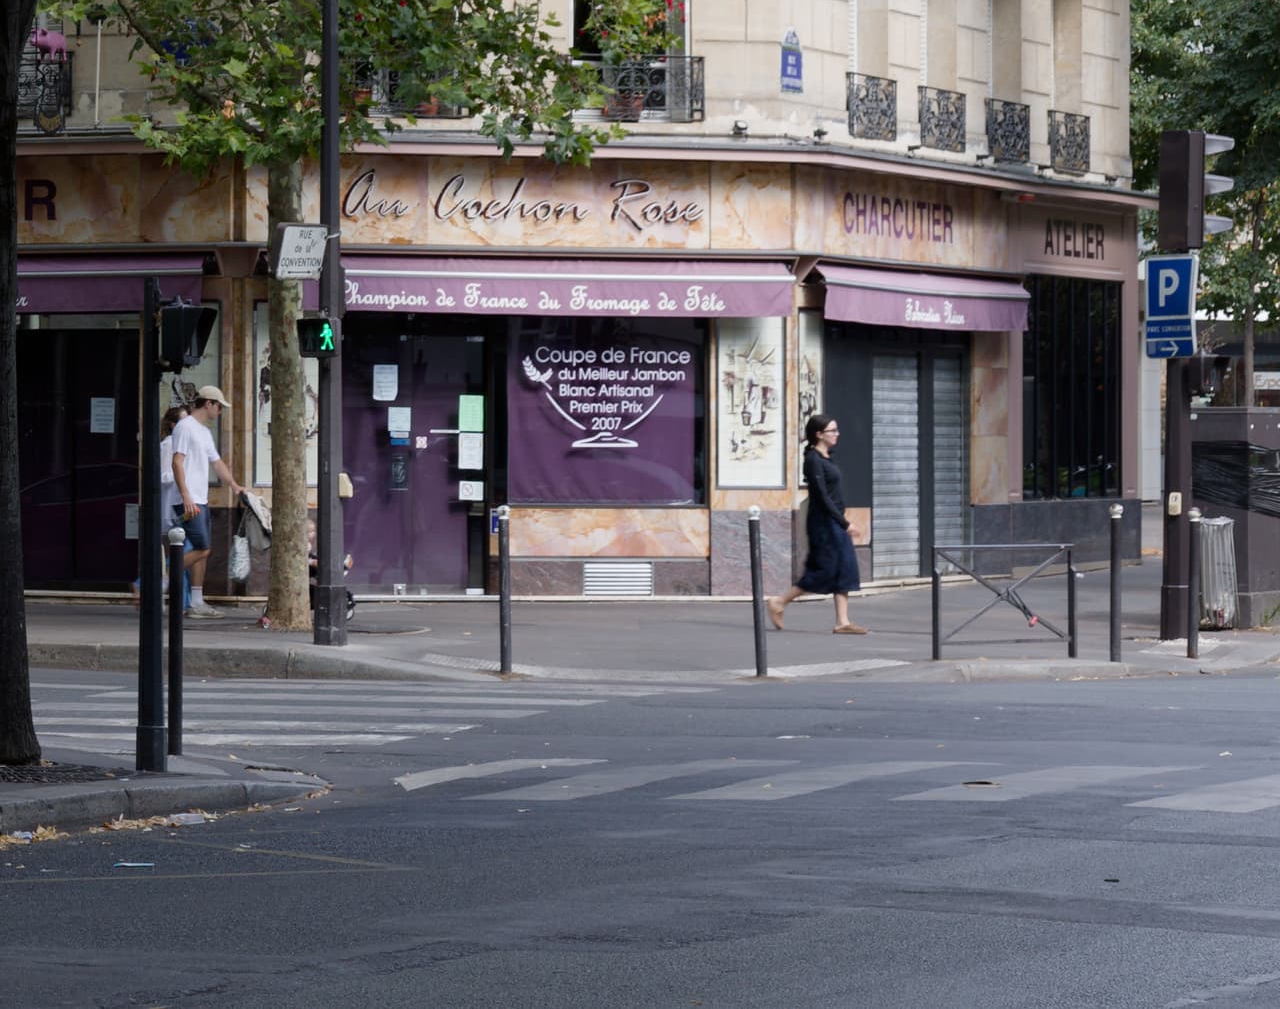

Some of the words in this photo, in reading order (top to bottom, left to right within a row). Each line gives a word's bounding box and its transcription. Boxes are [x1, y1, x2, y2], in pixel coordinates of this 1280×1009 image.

[342, 168, 409, 220] Au
[435, 174, 591, 221] Cochon
[609, 178, 705, 232] Rose
[843, 192, 954, 244] CHARCUTIER
[299, 230, 312, 240] RUE
[1044, 218, 1105, 261] ATELIER
[280, 257, 322, 268] CONVENTION
[1159, 268, 1179, 307] P
[344, 279, 428, 306] Champion
[436, 289, 455, 307] de
[464, 283, 528, 309] France
[538, 291, 560, 311] du
[570, 285, 651, 314] Fromage
[657, 292, 678, 310] de
[684, 285, 726, 312] Tête
[536, 346, 597, 367] Coupe
[601, 347, 625, 363] de
[631, 347, 691, 364] France
[558, 368, 576, 380] du
[578, 368, 630, 381] Meilleur
[631, 369, 686, 381] Jambon
[559, 384, 596, 397] Blanc
[598, 384, 654, 397] Artisanal
[570, 401, 618, 413] Premier
[621, 401, 644, 413] Prix
[591, 417, 622, 431] 2007
